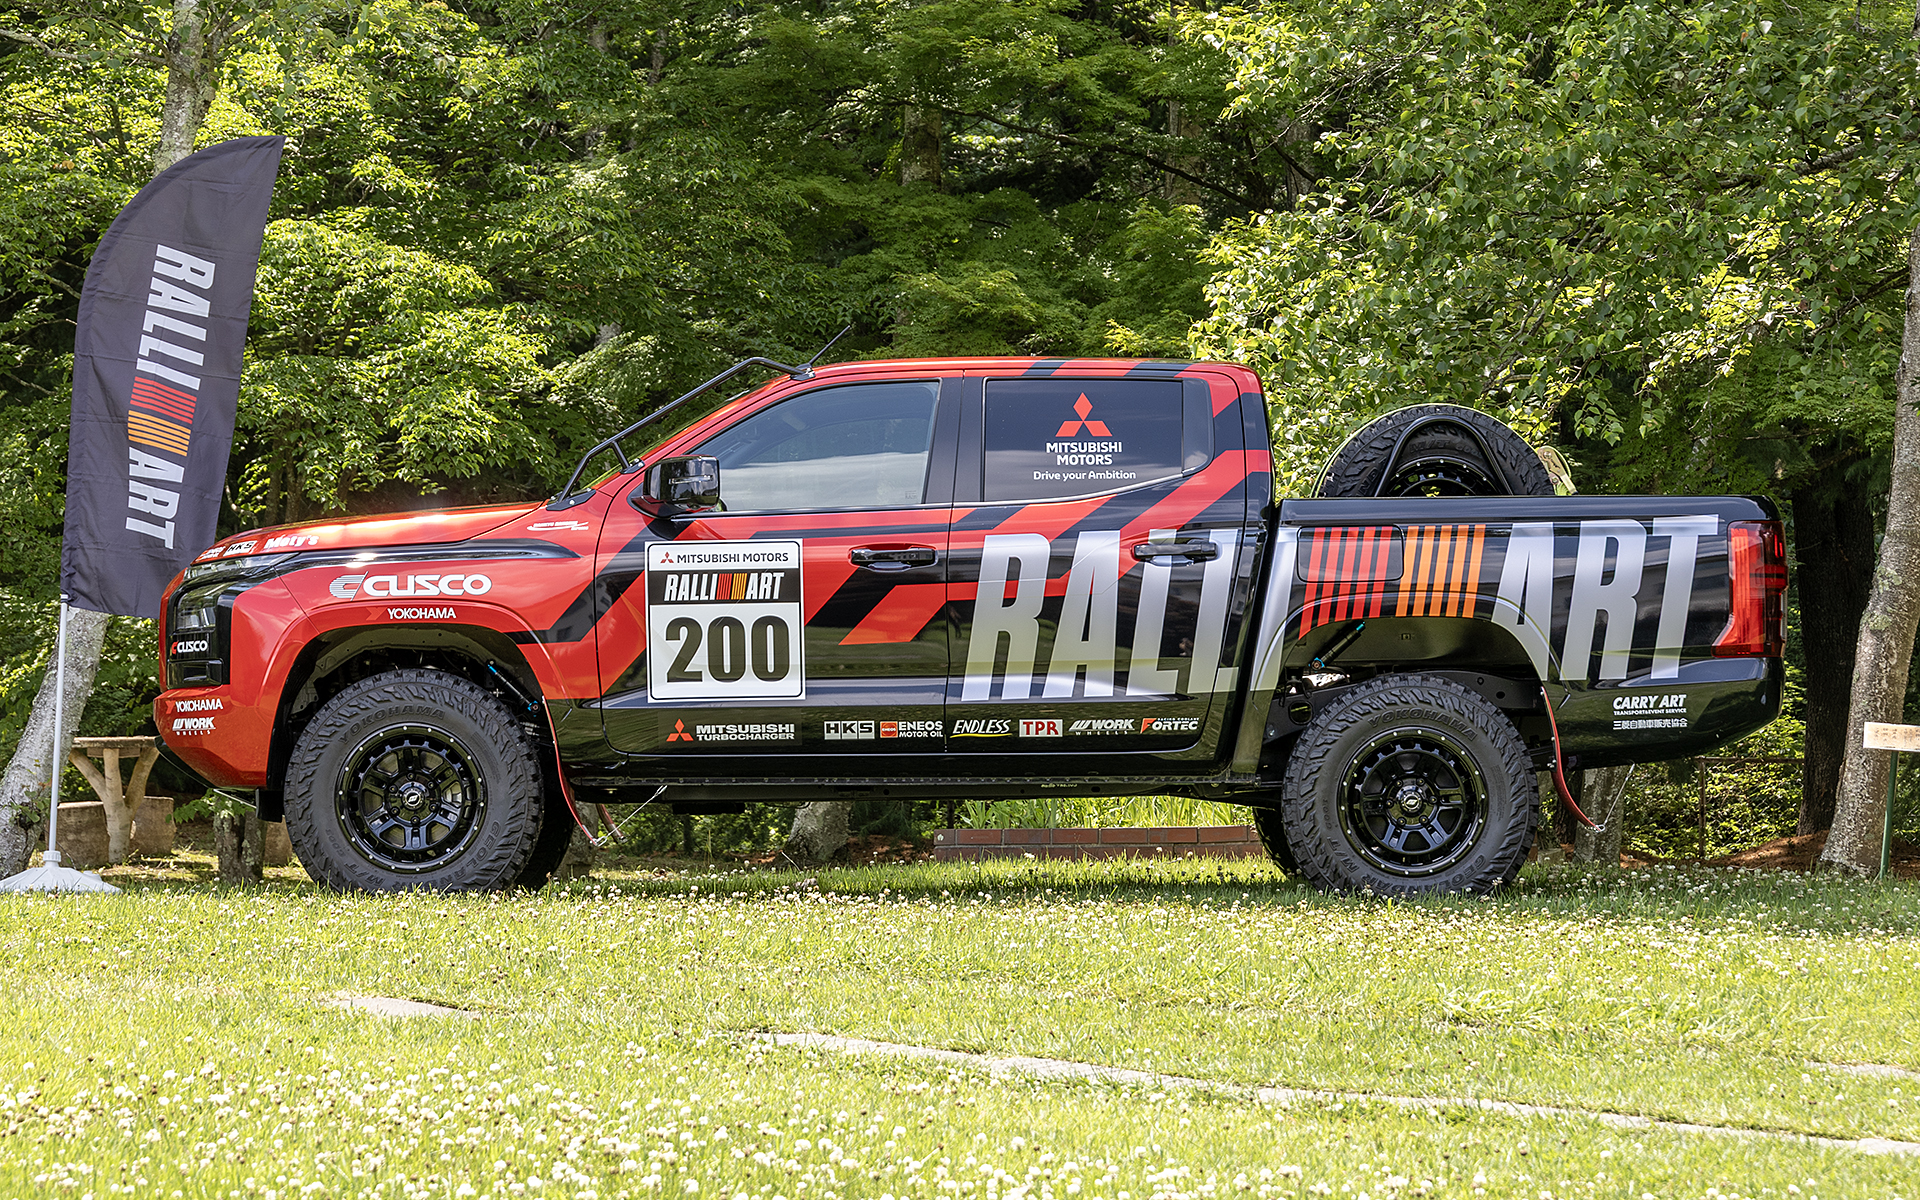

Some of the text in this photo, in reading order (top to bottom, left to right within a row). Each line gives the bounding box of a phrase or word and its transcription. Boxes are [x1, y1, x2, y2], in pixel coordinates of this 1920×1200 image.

[125, 243, 216, 550] RALLI ART
[1046, 441, 1123, 453] MITSUBISHI
[1056, 454, 1113, 466] MOTORS
[1033, 470, 1137, 482] Drive your Ambition
[226, 541, 255, 553] HKS
[263, 534, 320, 549] Moty's
[676, 552, 789, 564] MITSUBISHI MOTORS
[362, 573, 493, 597] CUSCO
[664, 572, 785, 602] RALLI ART
[1490, 514, 1719, 683] ART
[386, 607, 457, 620] YOKOHAMA
[176, 640, 208, 654] CUSCO
[665, 615, 790, 683] 200
[175, 698, 224, 713] YOKOHAMA
[1612, 694, 1687, 710] CARRY ART
[182, 716, 215, 730] WORK
[338, 702, 447, 745] YOKOHAMA
[695, 723, 796, 734] MITSUBISHI
[825, 721, 874, 736] HKS
[898, 720, 944, 731] ENEOS
[952, 719, 1012, 734] ENDLESS
[1022, 720, 1060, 736] TPR
[1090, 719, 1135, 730] WORK
[1140, 717, 1199, 734] FORTEC
[1367, 706, 1479, 742] YOKOHAMA
[696, 733, 795, 741] TURBOCHARGER
